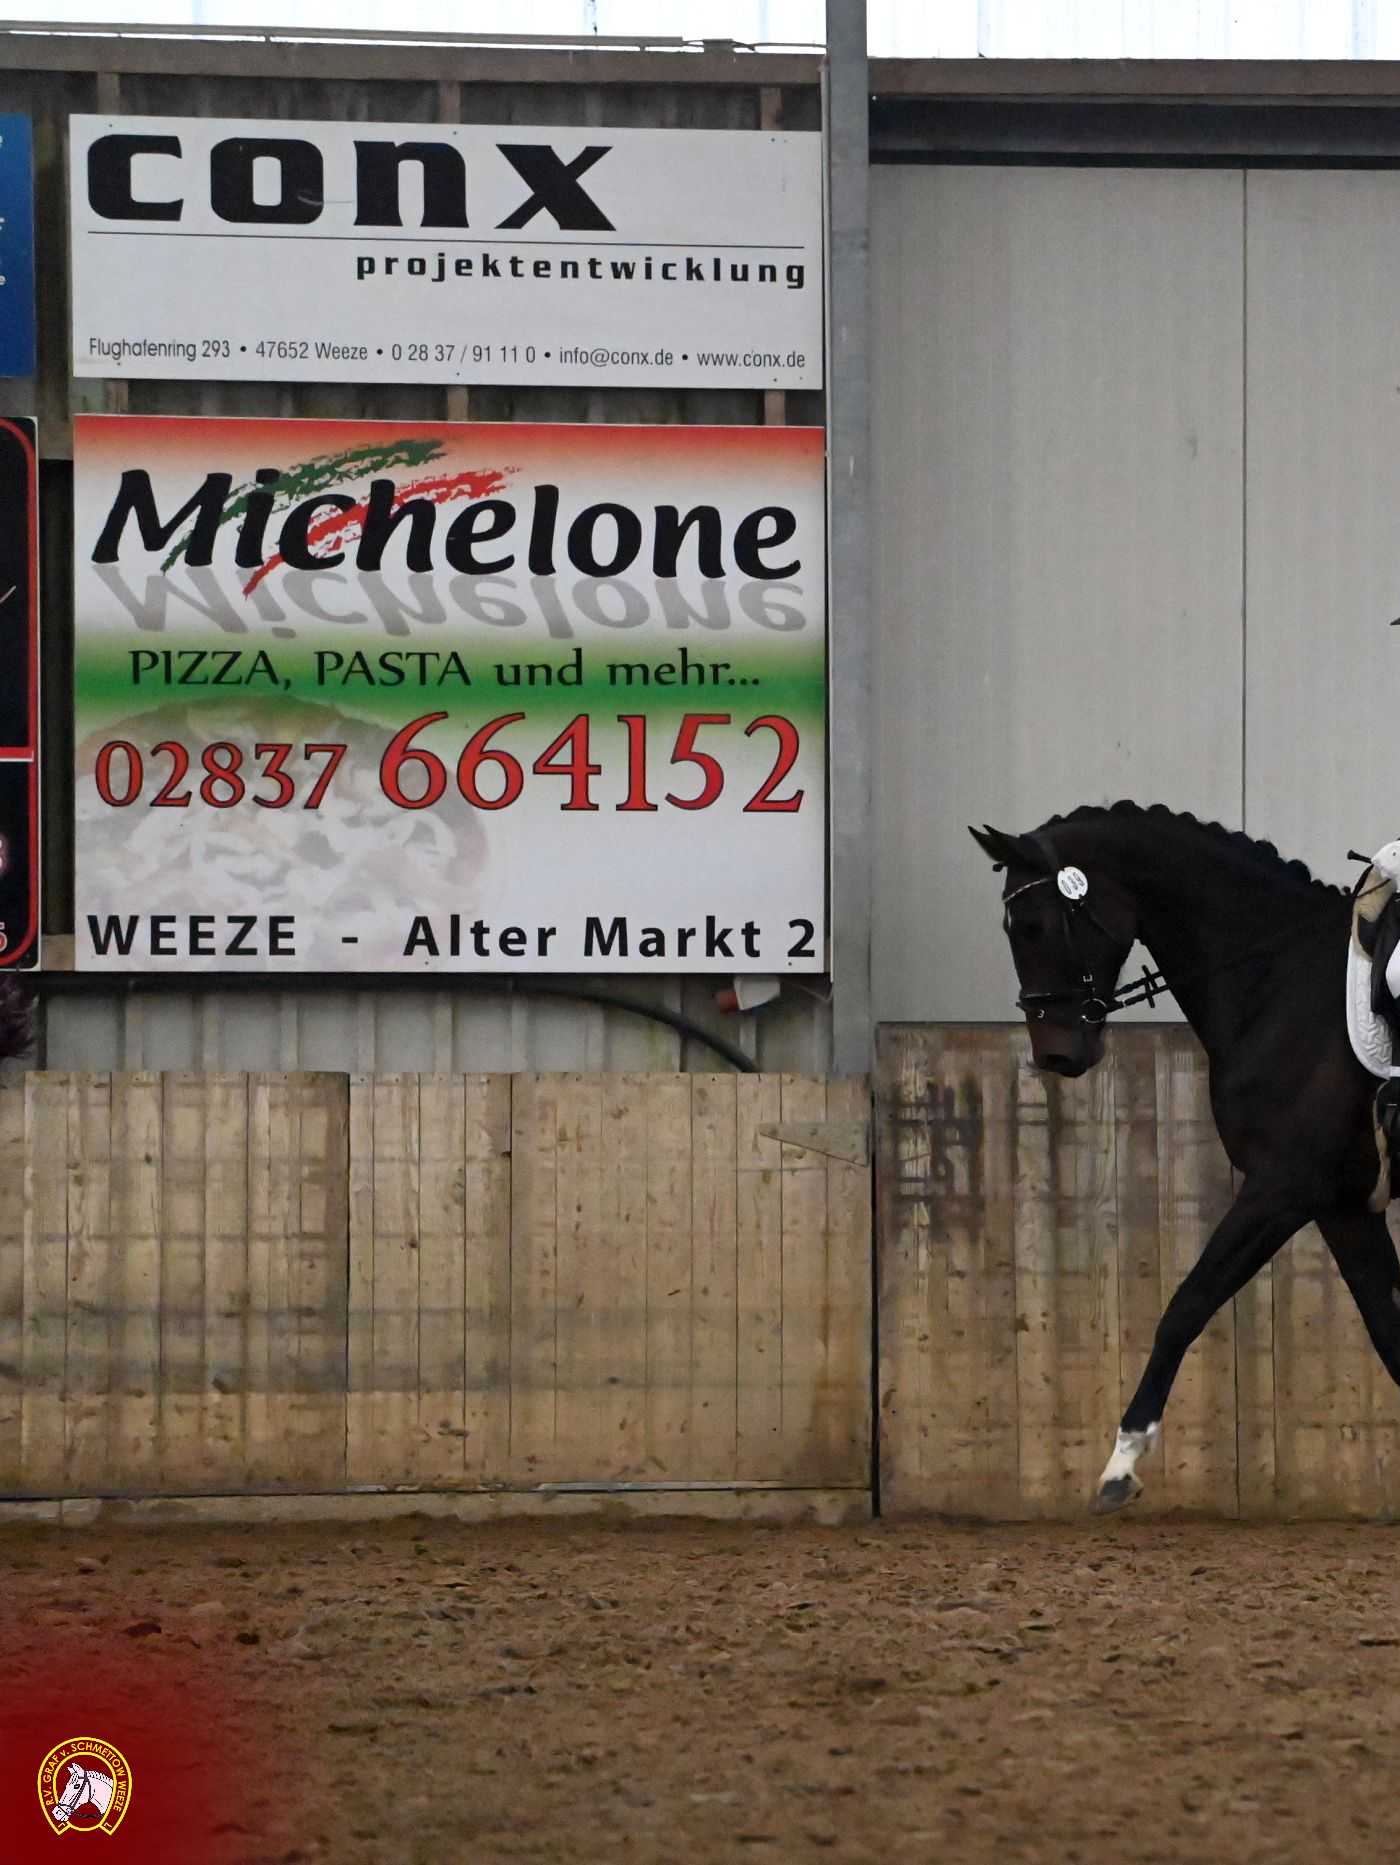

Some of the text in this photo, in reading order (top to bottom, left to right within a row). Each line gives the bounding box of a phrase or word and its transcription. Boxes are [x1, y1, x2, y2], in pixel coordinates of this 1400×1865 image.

[87, 133, 617, 232] conx
[356, 250, 805, 290] projektentwicklung
[89, 338, 197, 361] Flughafenring
[201, 340, 231, 358] 293
[255, 341, 309, 359] 47652
[315, 342, 368, 360] Weeze
[391, 344, 402, 361] 0
[407, 344, 429, 361] 28
[434, 345, 456, 362] 37
[472, 345, 491, 362] 91
[500, 346, 517, 363] 11
[525, 346, 536, 364] 0
[559, 346, 674, 368] info@conx.de
[697, 350, 806, 368] www.conx.de
[91, 467, 802, 579] Michelone
[129, 647, 762, 689] PIZZA, PASTA und mehr...
[94, 712, 803, 813] 02837 664152
[87, 914, 297, 956] WEEZE
[403, 913, 557, 957] Alter
[583, 915, 761, 958] Markt
[787, 918, 816, 958] 2
